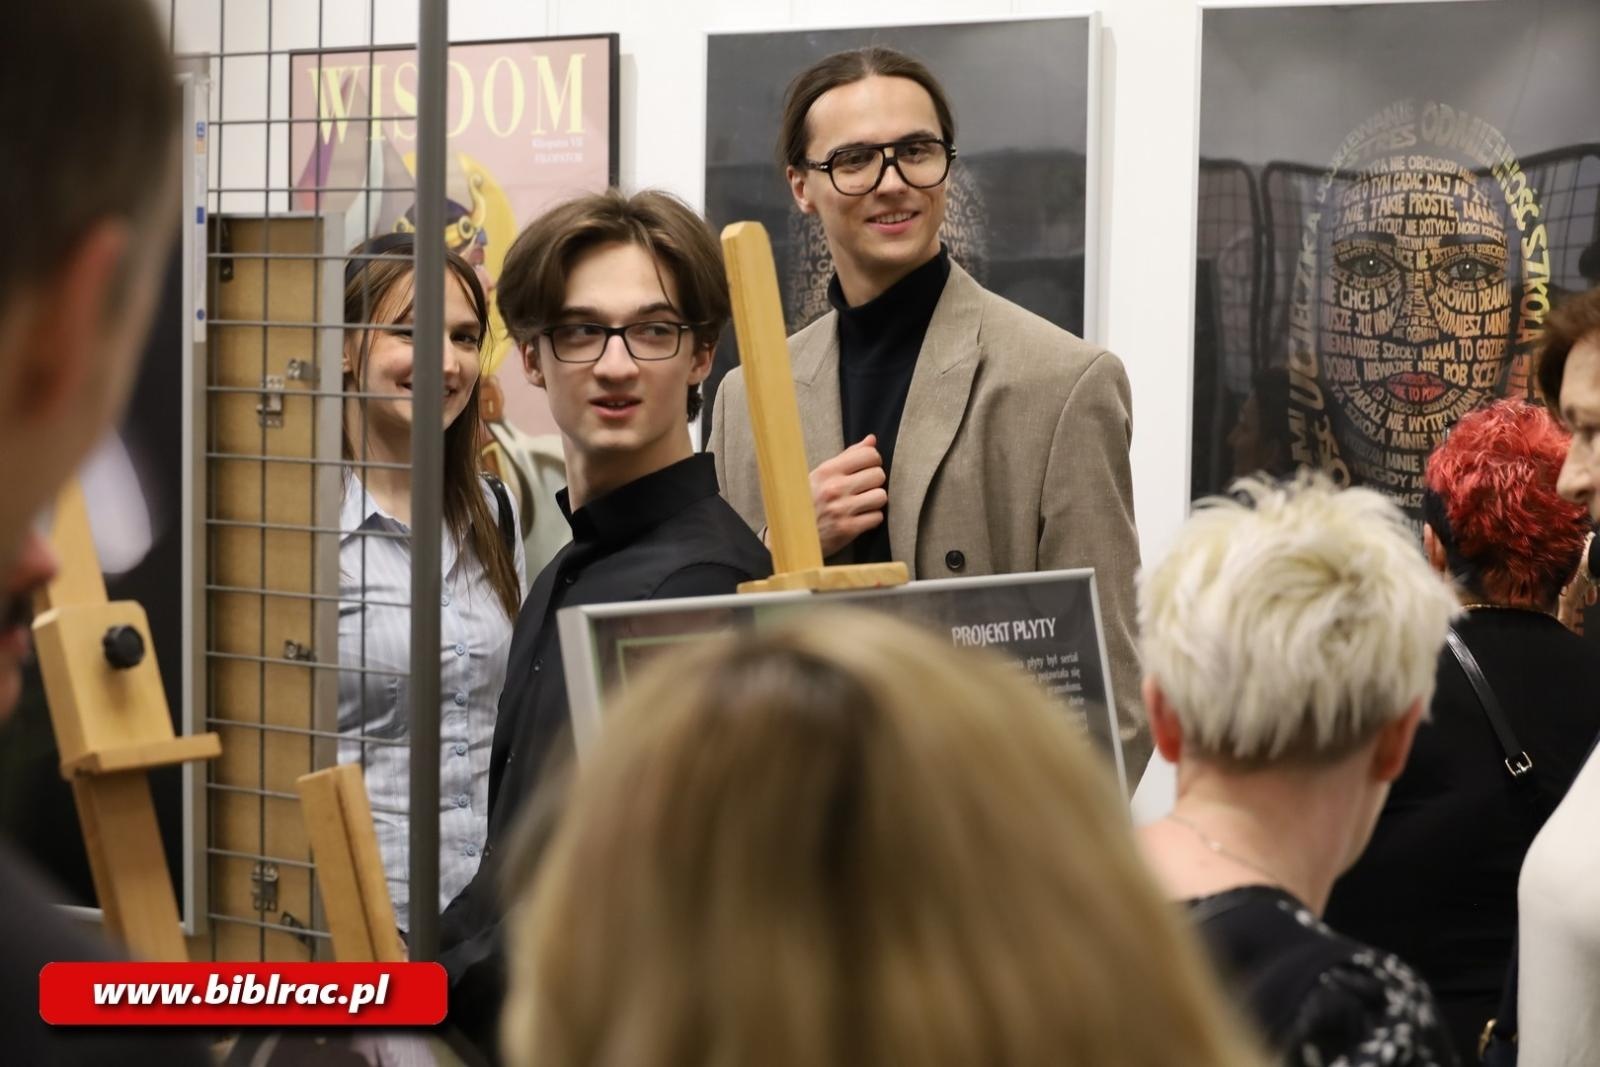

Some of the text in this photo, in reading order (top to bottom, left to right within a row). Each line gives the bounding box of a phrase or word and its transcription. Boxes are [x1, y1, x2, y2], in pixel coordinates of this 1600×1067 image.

[307, 53, 586, 145] WISDOM
[1371, 174, 1391, 198] TYM
[1427, 173, 1451, 194] DAJ
[1455, 179, 1469, 198] MI
[1342, 201, 1365, 225] NIE
[1370, 193, 1405, 219] TAKIE
[1409, 192, 1458, 222] PROSTE,
[1420, 218, 1456, 236] DOTYKAJ
[1339, 282, 1372, 311] CHCE
[1458, 337, 1474, 361] TO
[1417, 360, 1440, 377] NIE
[1385, 411, 1406, 431] NIE
[1389, 431, 1428, 449] MNIE
[1385, 451, 1420, 473] MNIE
[951, 620, 1011, 648] PROJEKT
